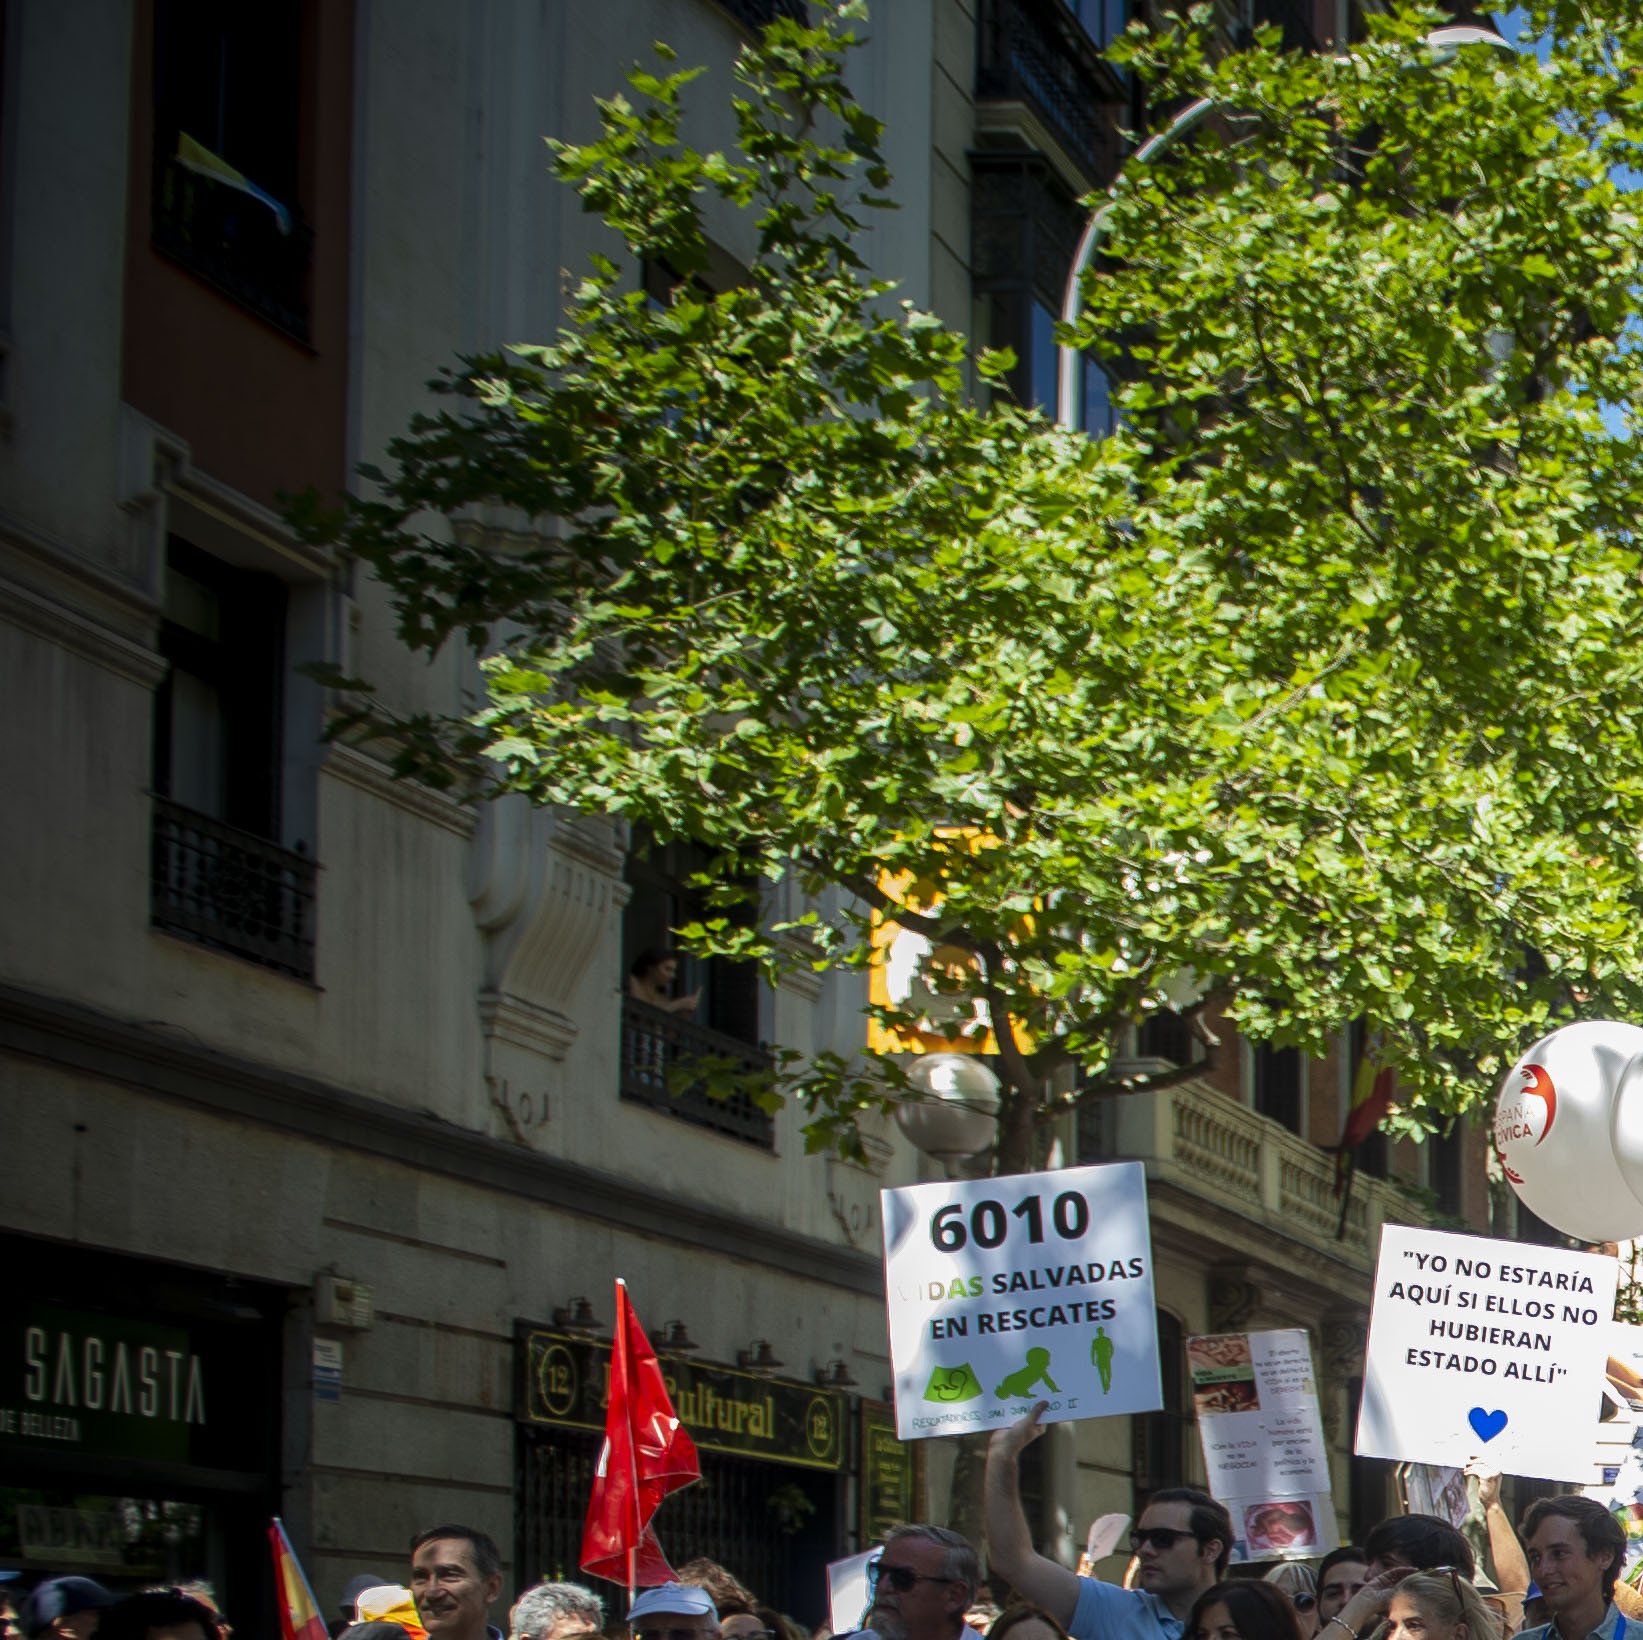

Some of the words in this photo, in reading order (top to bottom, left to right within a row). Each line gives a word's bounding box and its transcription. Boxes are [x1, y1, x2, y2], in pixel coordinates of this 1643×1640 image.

[930, 1191, 1089, 1253] 6010
[992, 1258, 1144, 1294] SALVADAS
[1403, 1251, 1447, 1273] "YO
[1455, 1258, 1491, 1279] NO
[1499, 1265, 1594, 1294] ESTARÍA
[932, 1316, 968, 1340] EN
[977, 1299, 1117, 1335] RESCATES
[1389, 1283, 1452, 1306] AQUÍ
[1457, 1291, 1477, 1309] SI
[1485, 1295, 1556, 1320] ELLOS
[1561, 1306, 1598, 1326] NO
[1429, 1320, 1552, 1351] HUBIERAN
[26, 1327, 206, 1425] SAGASTA
[548, 1364, 569, 1394] 12
[1406, 1348, 1497, 1376] ESTADO
[812, 1415, 828, 1440] 12
